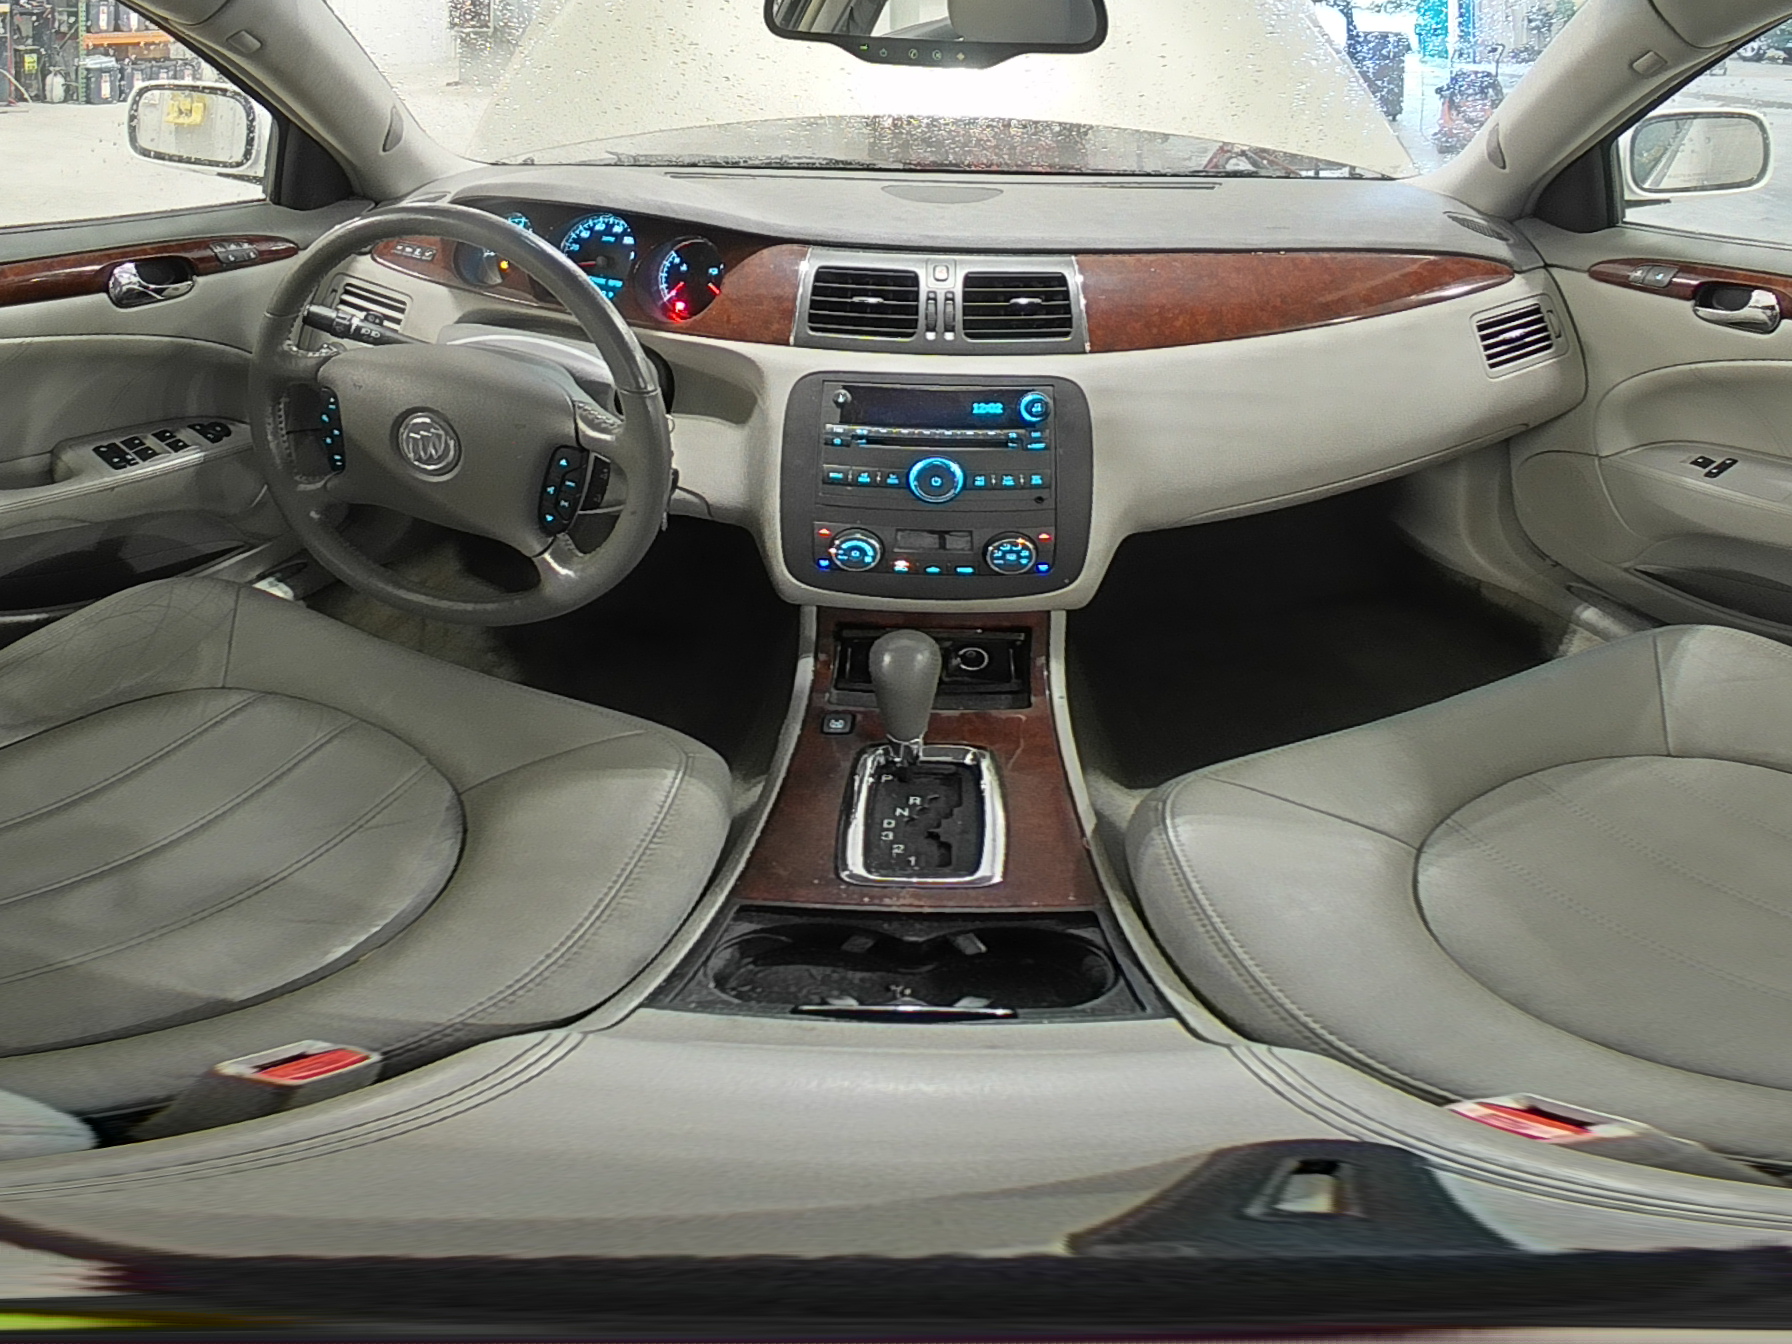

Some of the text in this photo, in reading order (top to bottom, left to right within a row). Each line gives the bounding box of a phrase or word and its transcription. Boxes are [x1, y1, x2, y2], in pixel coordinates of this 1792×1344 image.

[881, 774, 893, 783] P
[908, 796, 921, 805] R
[895, 807, 909, 816] N
[883, 819, 895, 828] D
[881, 831, 894, 840] 3
[892, 844, 905, 854] 2
[908, 855, 916, 866] 1
